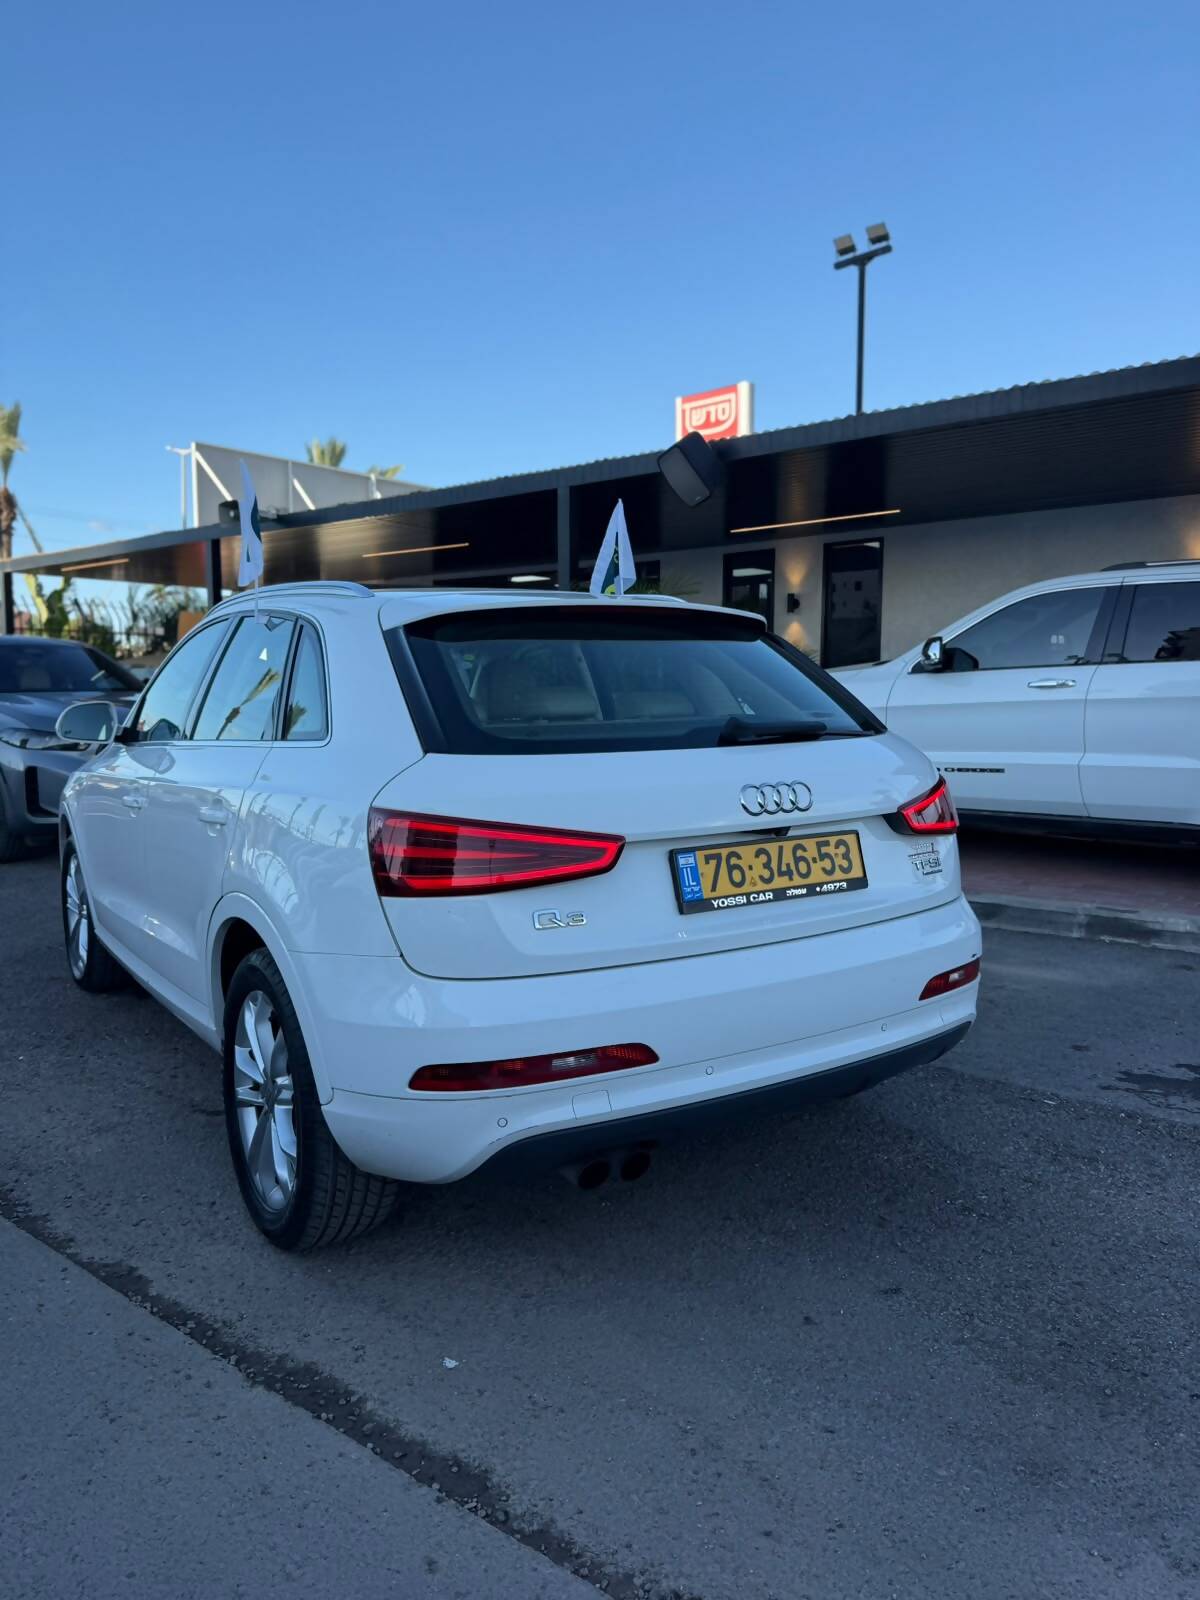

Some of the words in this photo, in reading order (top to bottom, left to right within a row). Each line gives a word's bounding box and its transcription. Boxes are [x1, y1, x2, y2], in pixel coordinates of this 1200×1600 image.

[683, 867, 697, 886] IL
[711, 895, 747, 909] YOSSI
[750, 891, 774, 902] CAR
[533, 909, 587, 930] Q3
